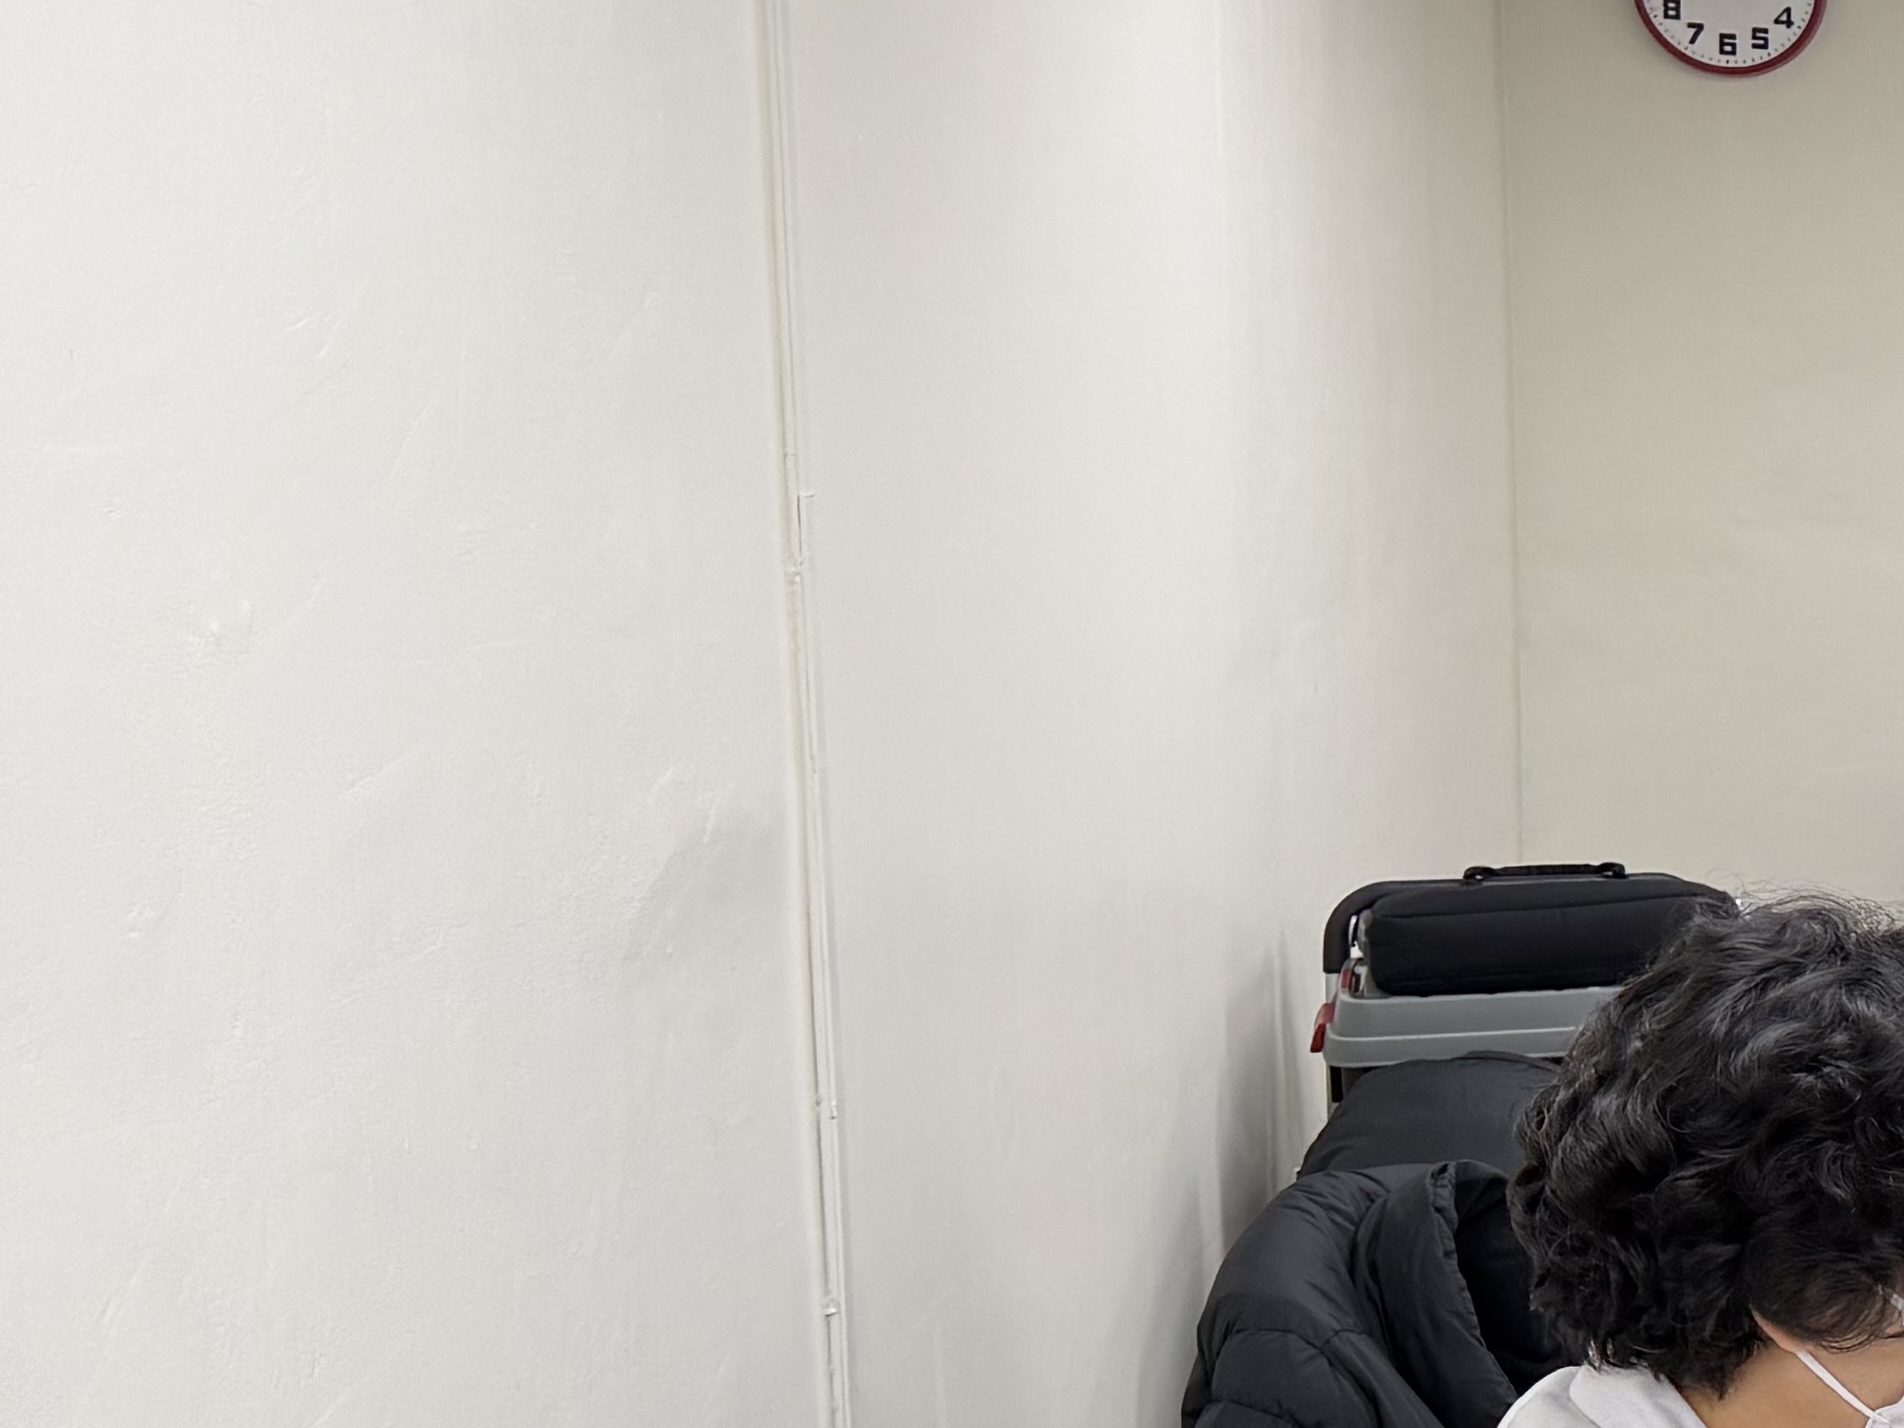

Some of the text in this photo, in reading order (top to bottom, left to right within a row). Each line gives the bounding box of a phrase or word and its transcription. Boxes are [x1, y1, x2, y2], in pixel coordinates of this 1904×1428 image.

[1773, 7, 1794, 29] 4
[1687, 22, 1704, 45] 7
[1718, 33, 1737, 56] 6
[1751, 27, 1769, 50] 5
